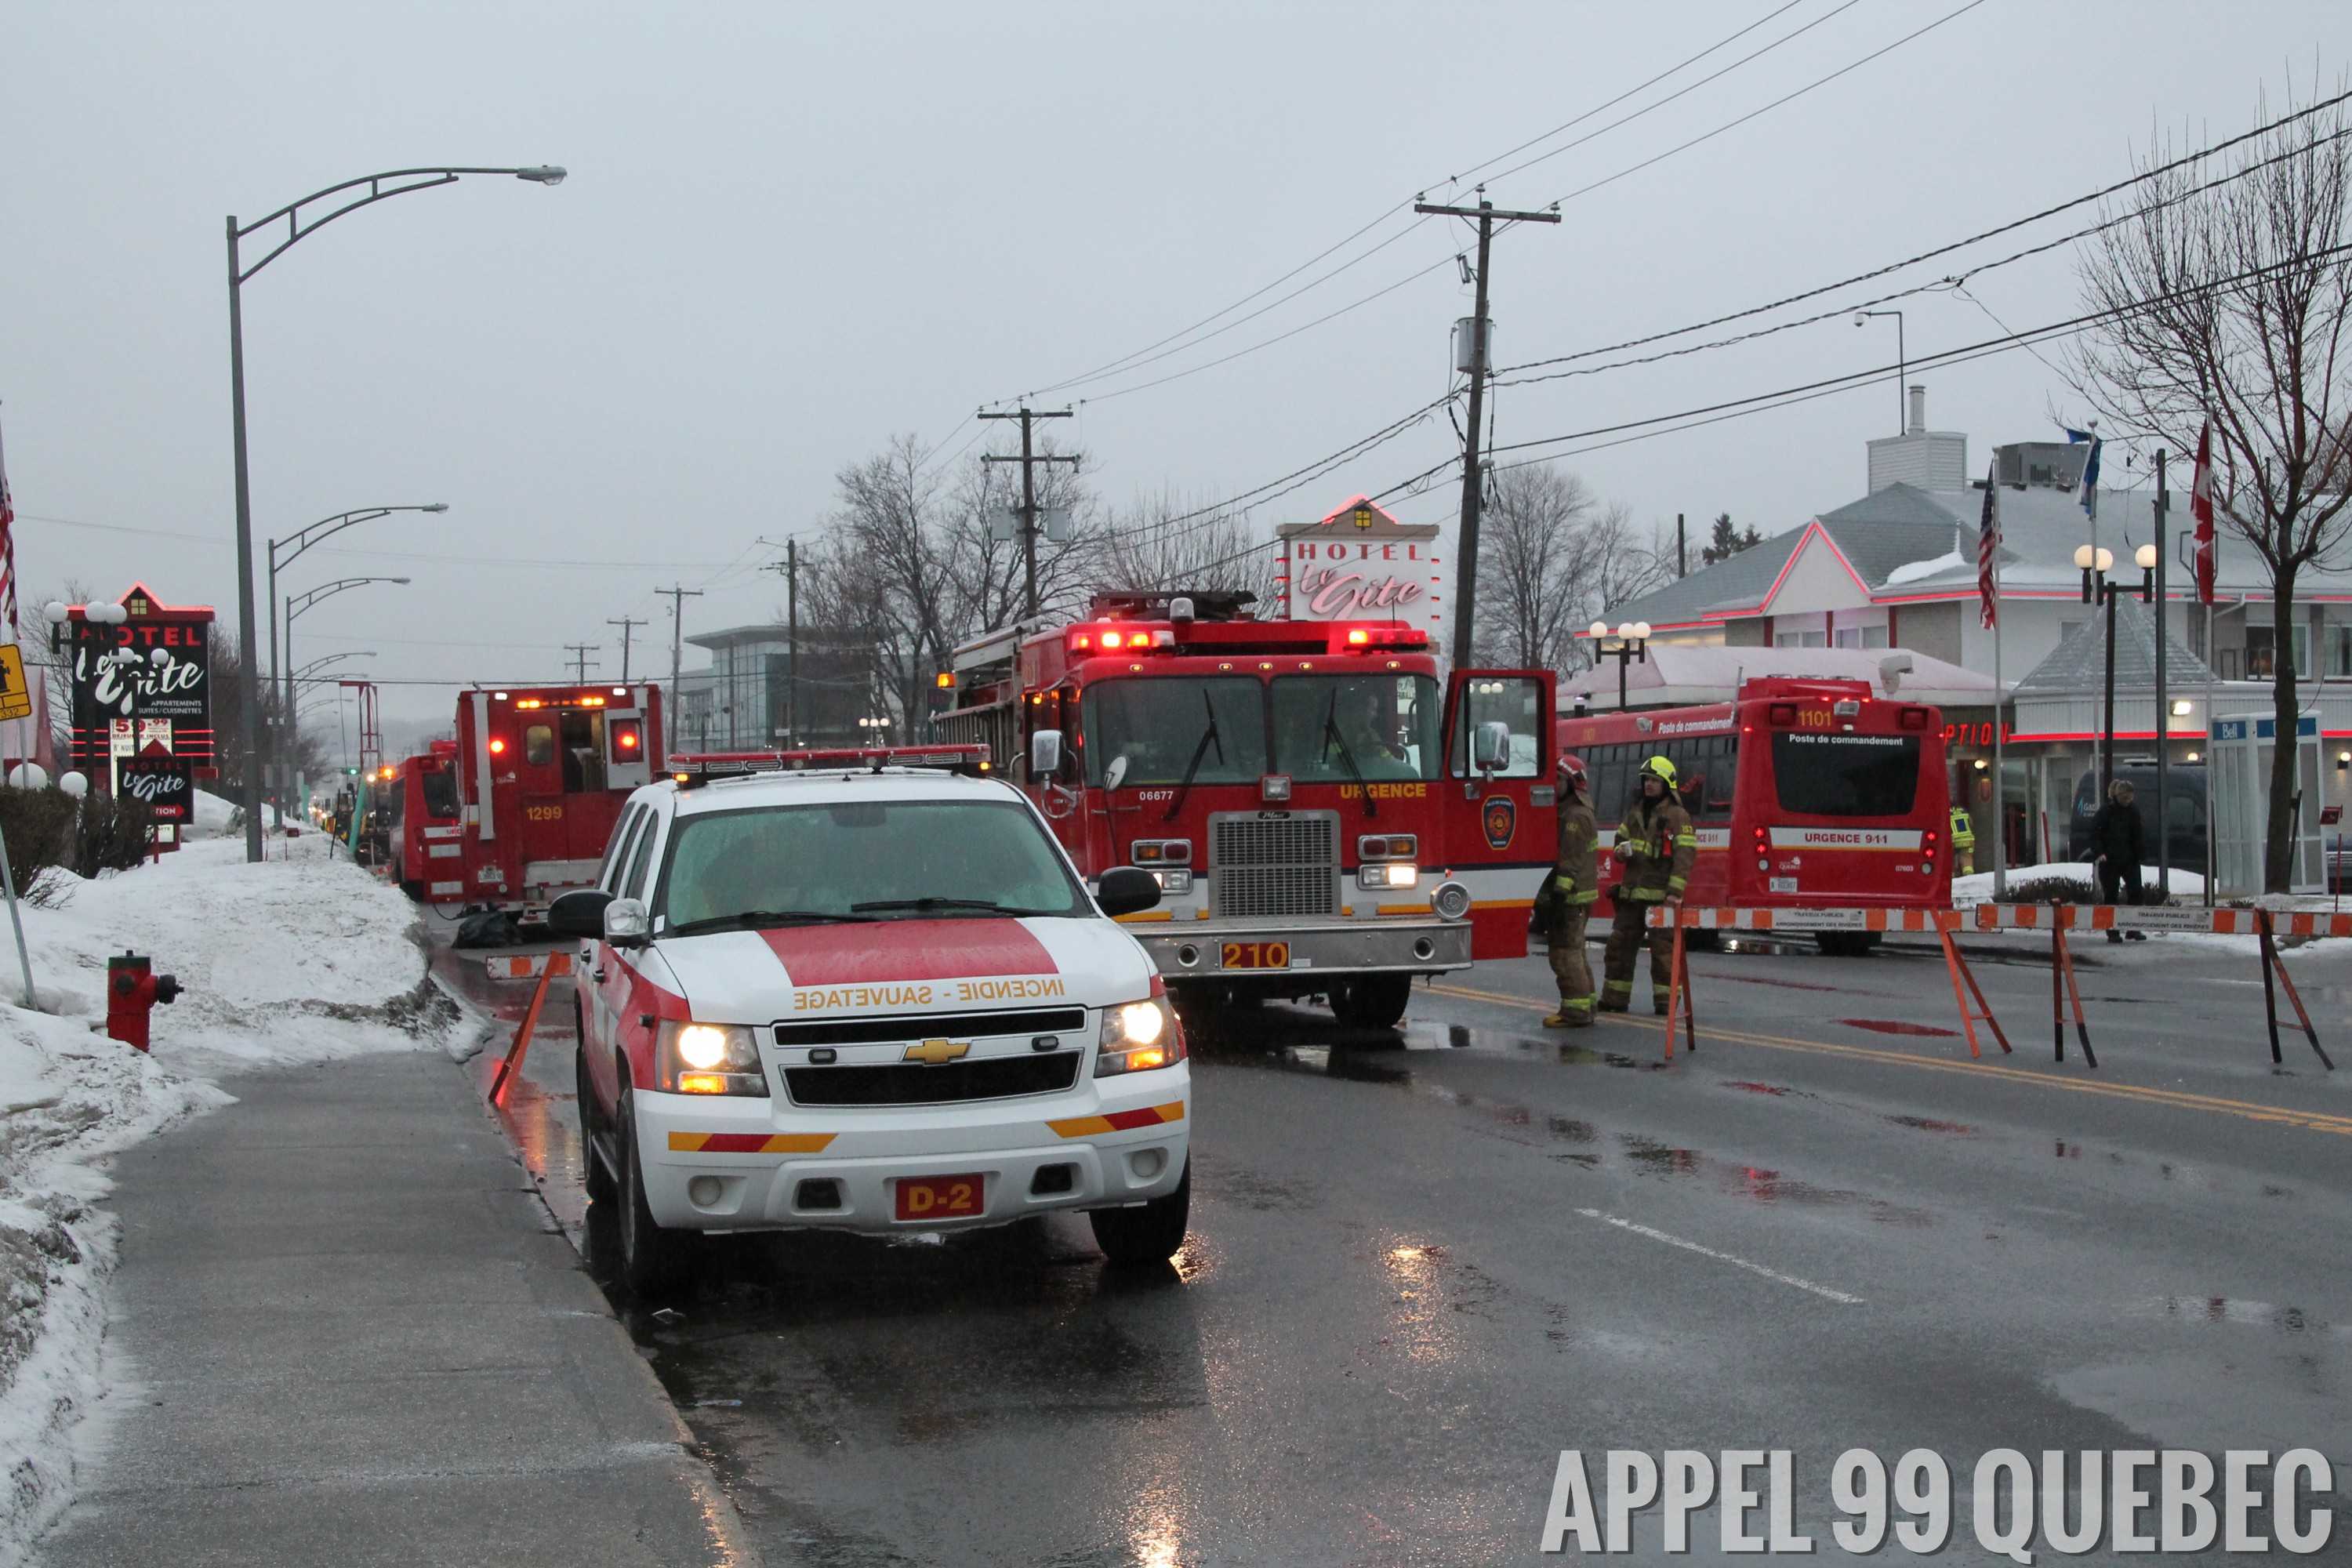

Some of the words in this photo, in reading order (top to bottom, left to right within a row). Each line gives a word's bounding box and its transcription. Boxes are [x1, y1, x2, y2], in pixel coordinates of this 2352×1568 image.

[1298, 543, 1424, 561] HOTEL
[1300, 564, 1337, 593] Le
[1800, 710, 1831, 727] 1101
[1658, 722, 1675, 734] Poste
[1676, 720, 1684, 732] de
[2222, 723, 2238, 739] Bell
[1789, 734, 1815, 743] Poste
[1817, 735, 1829, 743] de
[1831, 736, 1904, 746] commandement
[1340, 784, 1427, 799] URGENCE
[527, 806, 563, 820] 1299
[1805, 833, 1860, 844] URGENCE
[1224, 943, 1287, 968] 210
[908, 1183, 971, 1211] D-2
